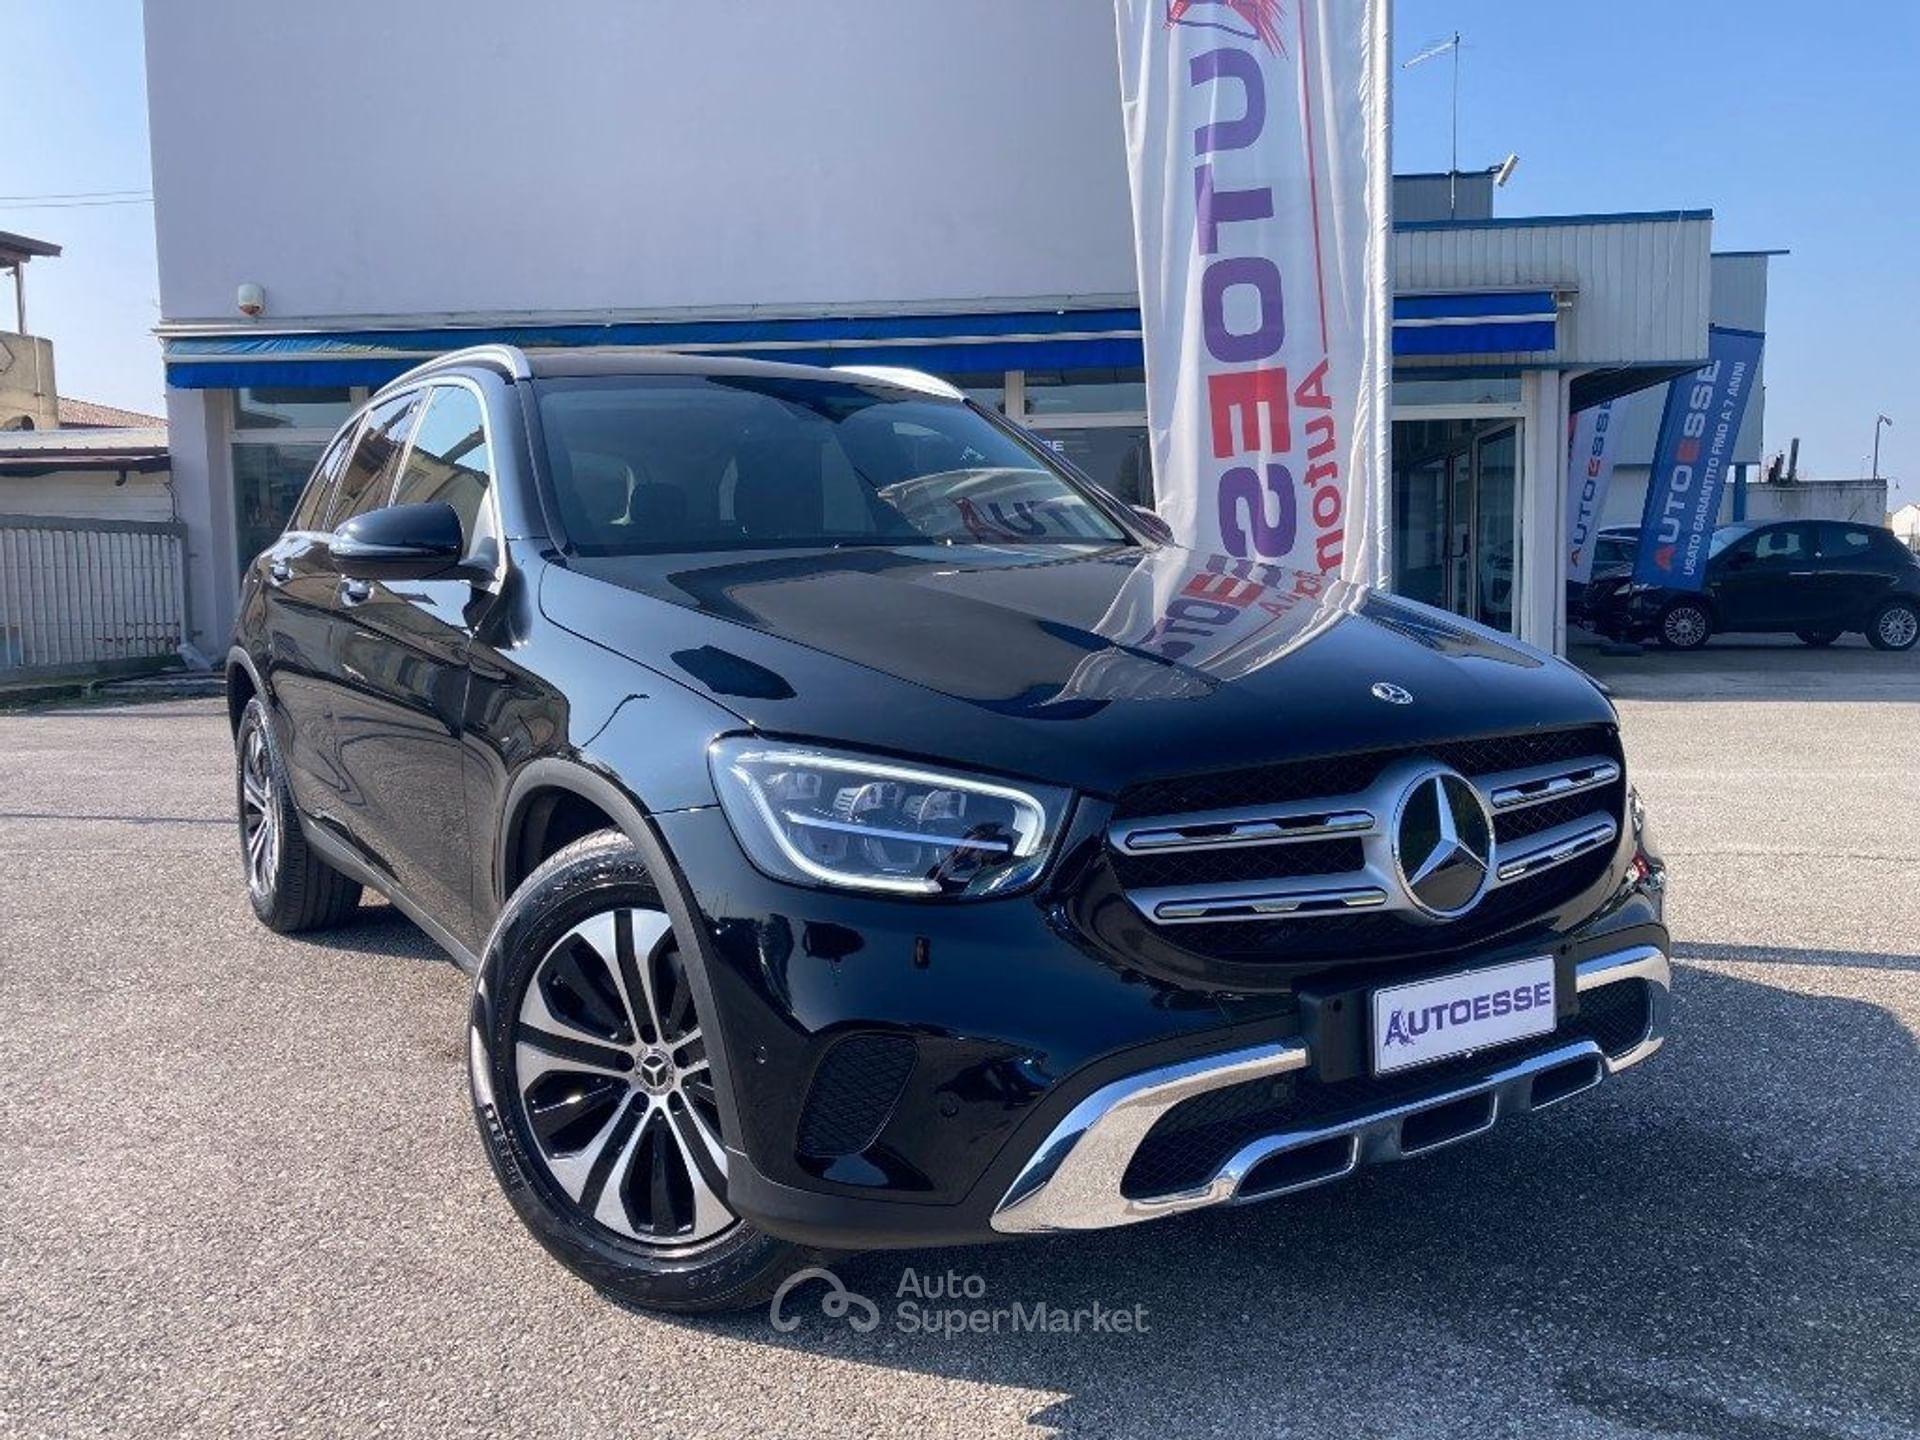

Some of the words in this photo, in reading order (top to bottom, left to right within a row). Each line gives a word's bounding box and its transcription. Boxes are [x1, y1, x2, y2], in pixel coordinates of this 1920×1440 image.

[1727, 361, 1747, 397] ANNI
[1721, 410, 1732, 421] A
[1723, 400, 1735, 409] 7
[1711, 423, 1729, 455] FINO
[1655, 360, 1720, 571] AUTOESSE
[1692, 457, 1719, 532] GARANTITO
[1683, 534, 1701, 576] USATO
[1384, 982, 1551, 1048] AUTOESSE
